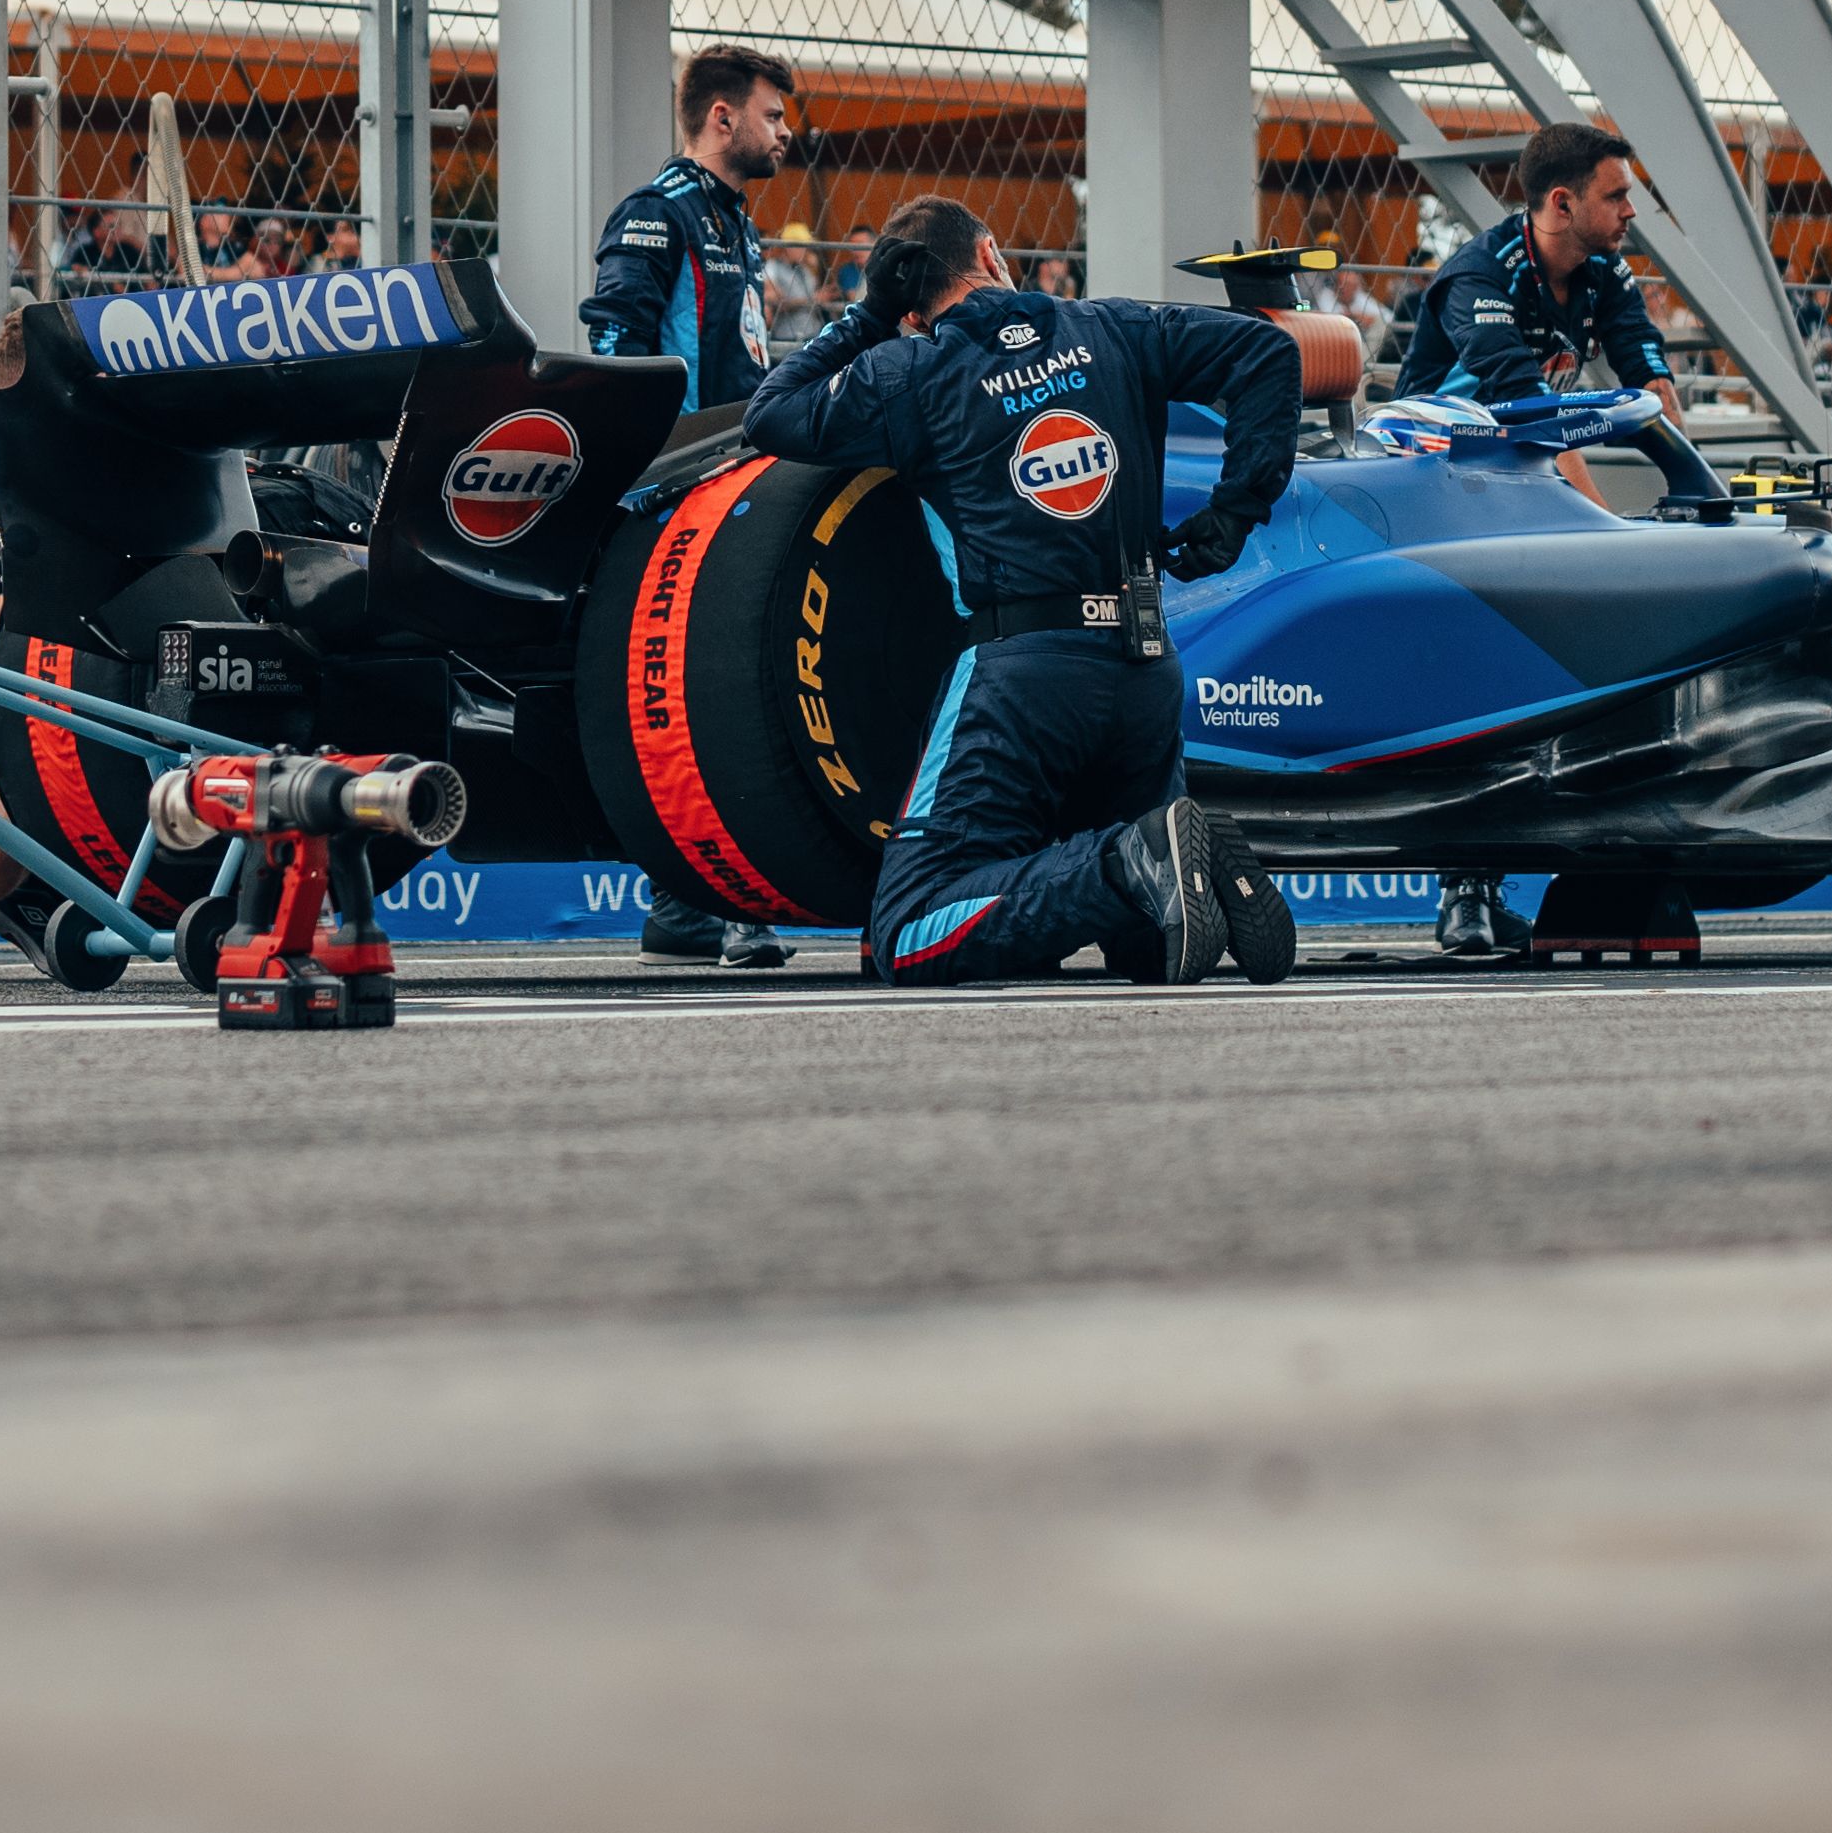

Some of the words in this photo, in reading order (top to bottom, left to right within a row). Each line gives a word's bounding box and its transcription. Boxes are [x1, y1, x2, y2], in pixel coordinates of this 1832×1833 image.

[624, 219, 668, 232] Acronis
[158, 268, 440, 367] kraken
[998, 323, 1041, 349] OMP
[980, 345, 1093, 398] WILLIAMS
[1002, 370, 1087, 415] RACING
[1451, 425, 1494, 438] SARGEANT
[451, 456, 572, 496] Gulf
[1018, 441, 1108, 488] Gulf
[649, 527, 699, 623] RIGHT
[1082, 599, 1120, 622] OM
[198, 644, 253, 692] sia
[257, 658, 283, 671] spinal
[642, 637, 668, 732] REAR
[796, 568, 862, 797] ZERO
[1200, 706, 1280, 728] Ventures
